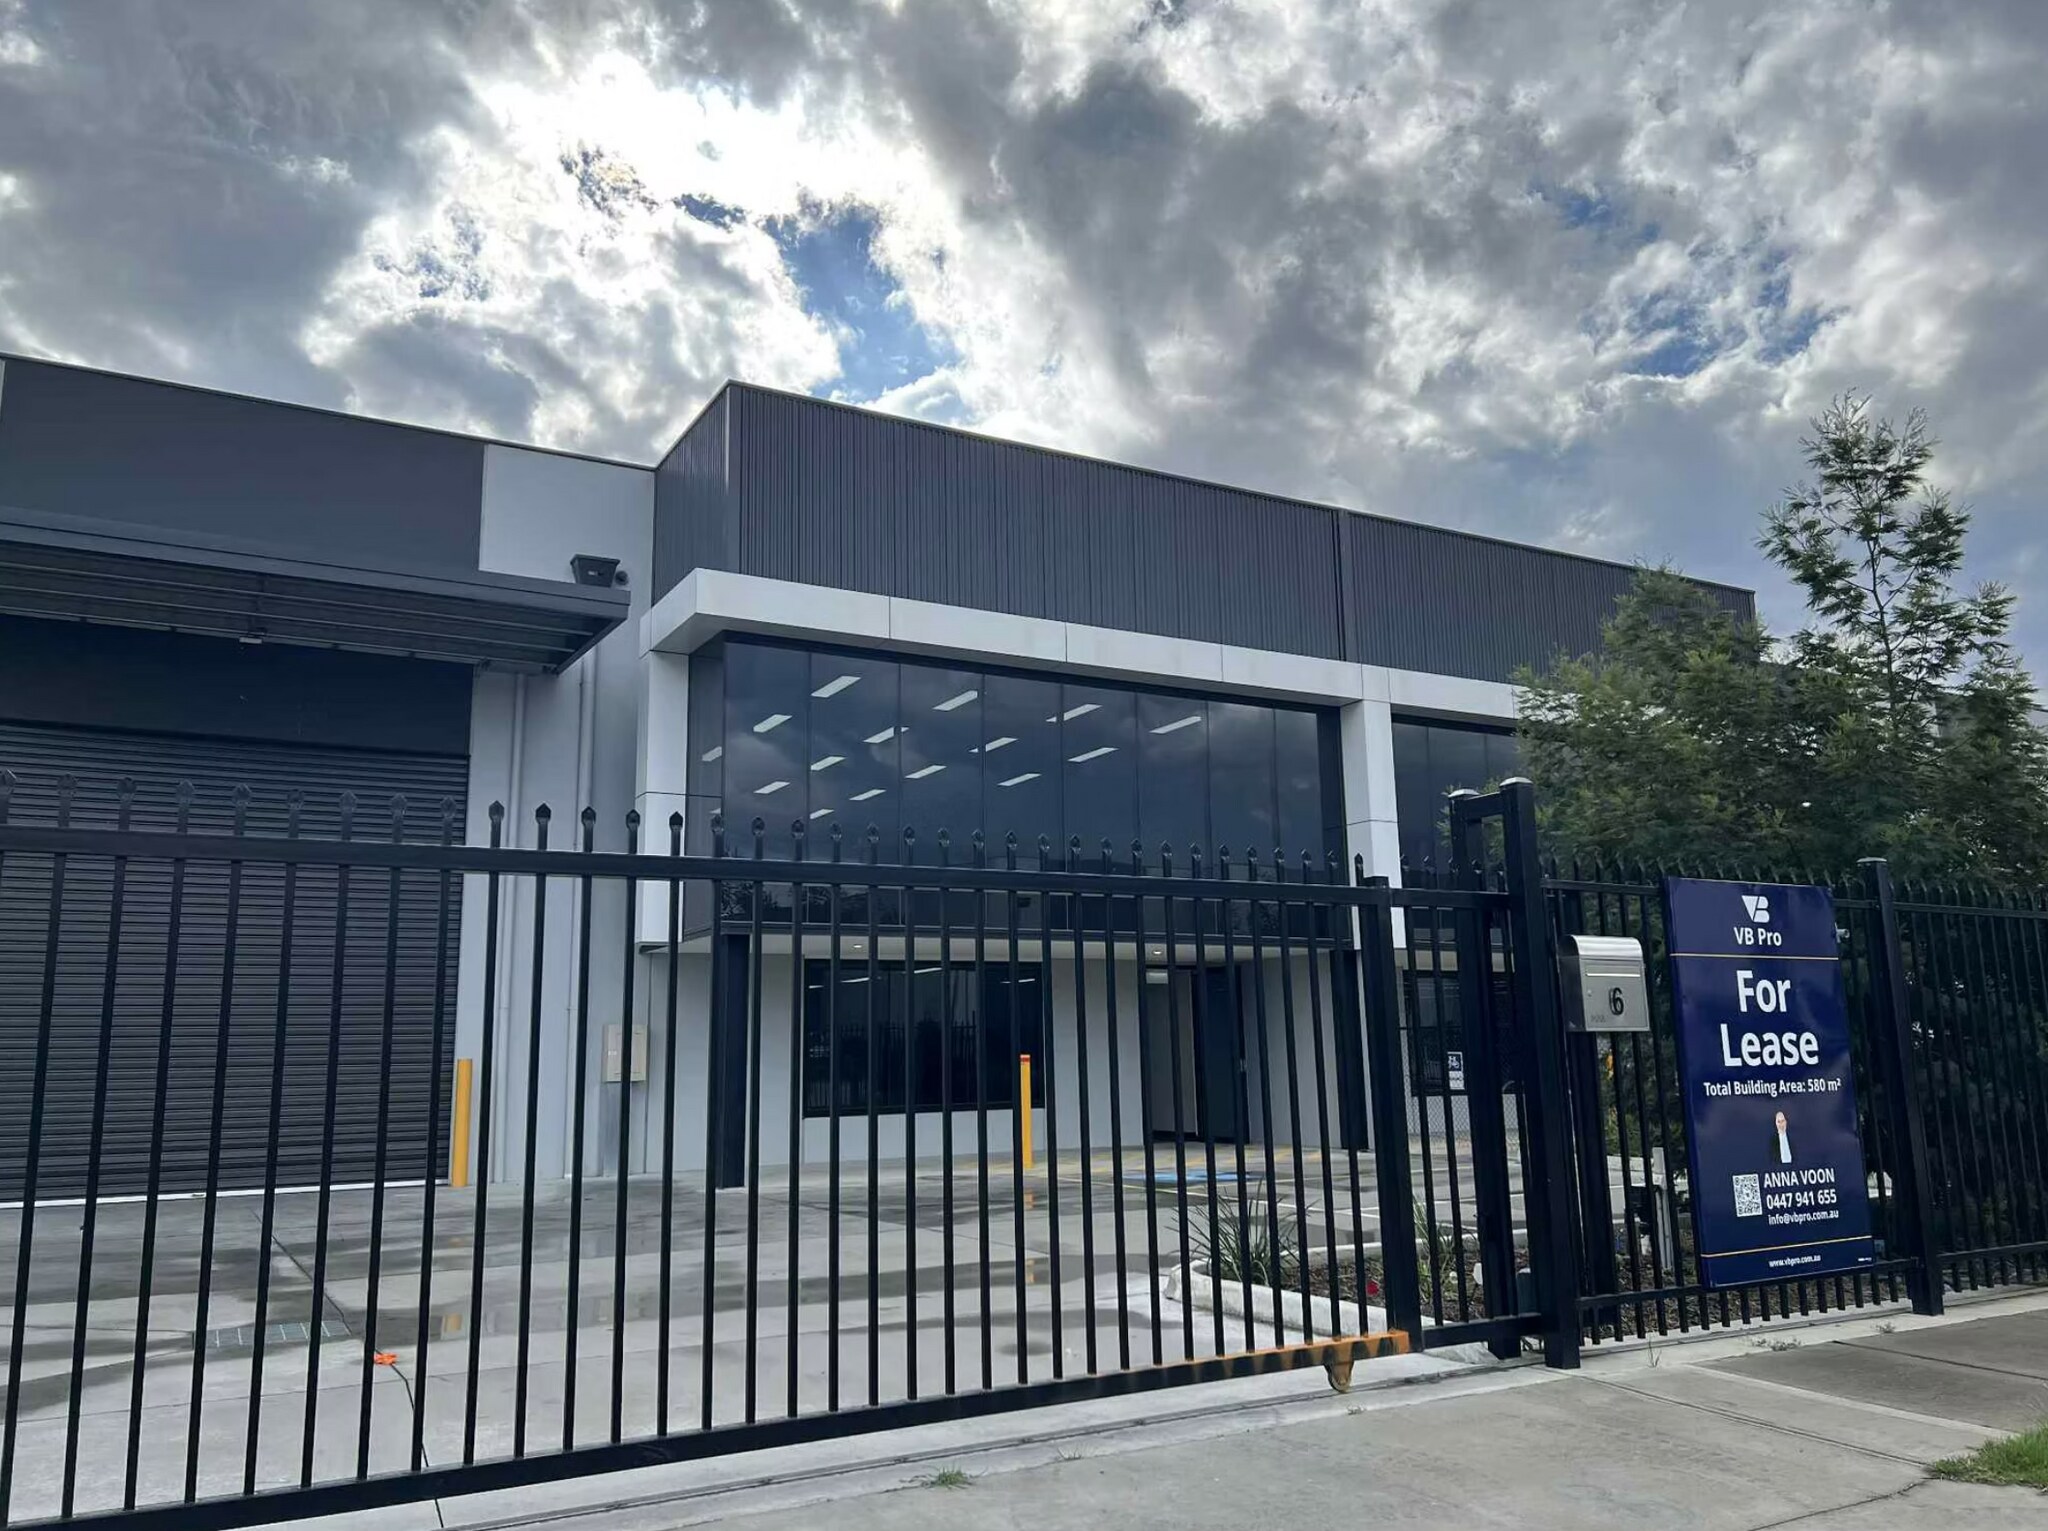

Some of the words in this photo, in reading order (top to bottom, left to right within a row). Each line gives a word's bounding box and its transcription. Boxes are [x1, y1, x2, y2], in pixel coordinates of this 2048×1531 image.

[1733, 927, 1754, 945] VB
[1757, 928, 1782, 946] Pro
[1608, 987, 1625, 1016] 6
[1736, 970, 1791, 1013] For
[1720, 1023, 1819, 1067] Lease
[1703, 1081, 1732, 1096] Total
[1734, 1079, 1777, 1098] Building
[1779, 1079, 1806, 1093] Area:
[1807, 1079, 1826, 1093] 580
[1763, 1172, 1799, 1188] ANNA
[1799, 1168, 1835, 1184] VOON
[1766, 1193, 1793, 1210] 0447
[1796, 1191, 1815, 1207] 941
[1818, 1189, 1837, 1204] 655
[1768, 1210, 1839, 1225] info@vbpro.com.au
